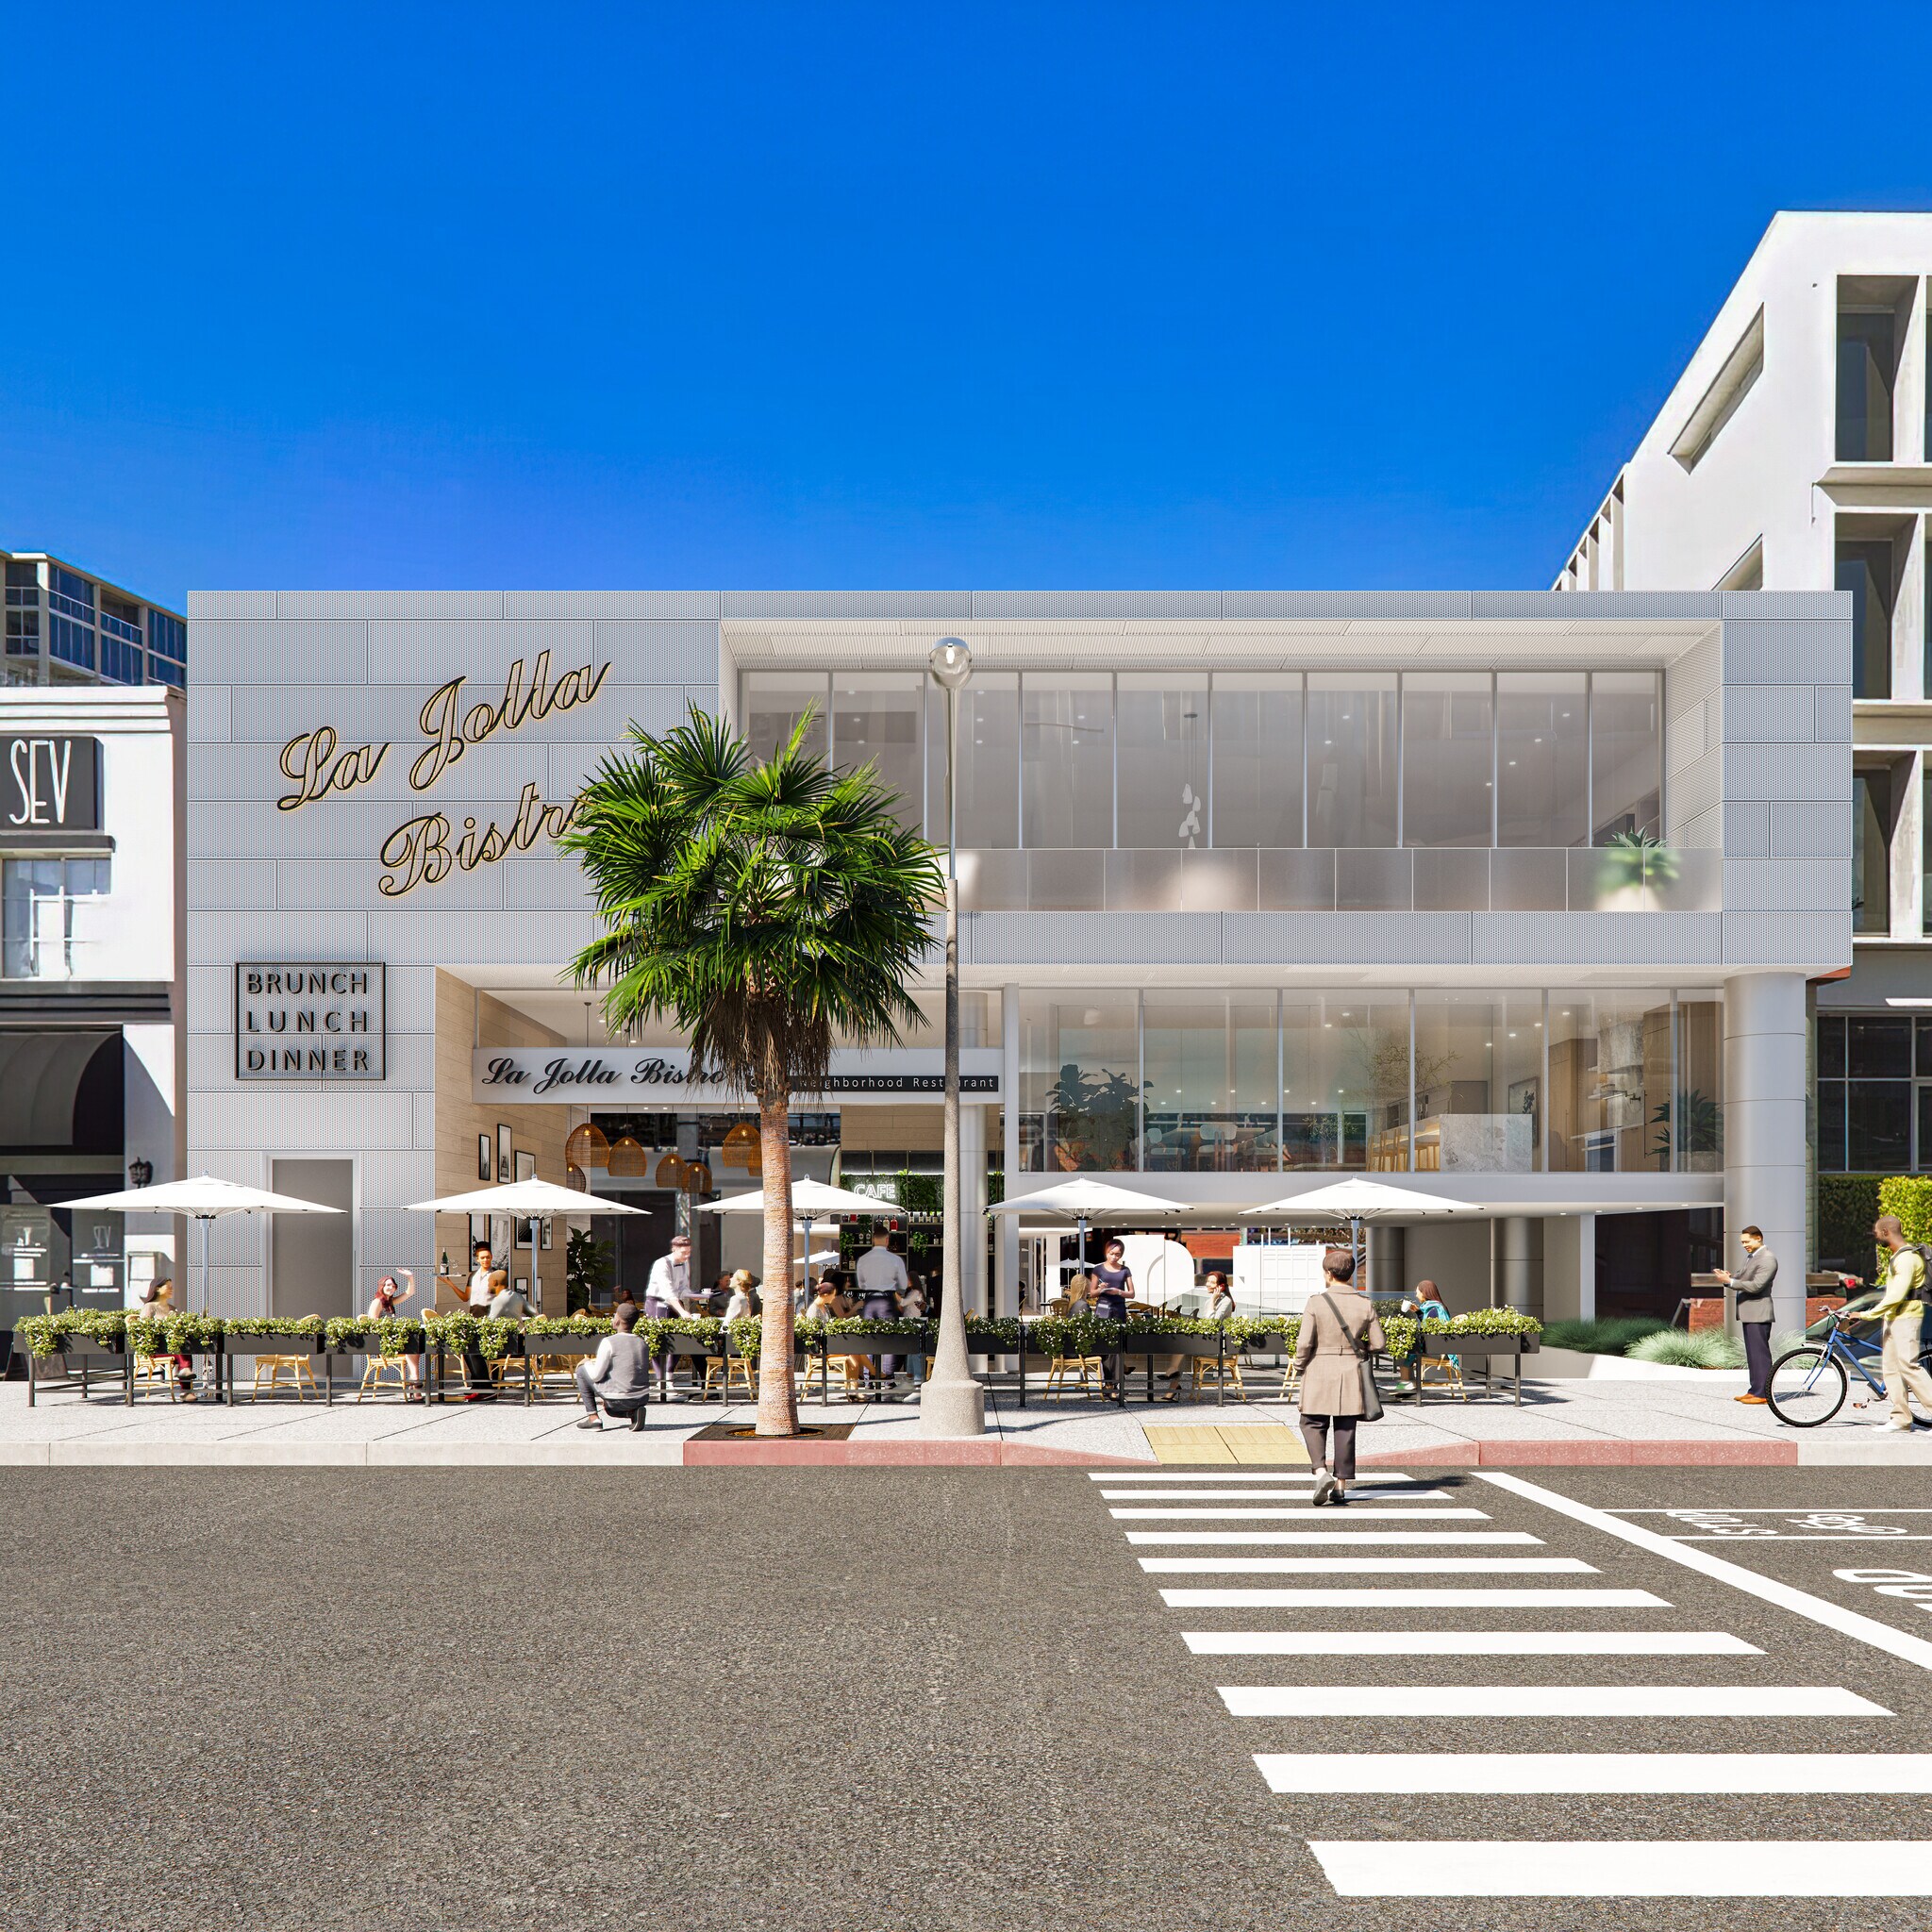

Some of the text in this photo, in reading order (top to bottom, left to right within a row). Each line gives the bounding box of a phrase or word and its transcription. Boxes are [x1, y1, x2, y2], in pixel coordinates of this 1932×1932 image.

[277, 649, 611, 811] La Jolla
[8, 739, 72, 824] SEV
[246, 973, 367, 994] BRUNCH
[246, 1011, 367, 1032] LUNCH
[246, 1049, 368, 1071] DINNER
[481, 1058, 532, 1084] La
[533, 1058, 622, 1094] Jolla
[913, 1077, 993, 1088] Restrant
[854, 1184, 895, 1198] CAFE
[1666, 1511, 1779, 1535] STOP
